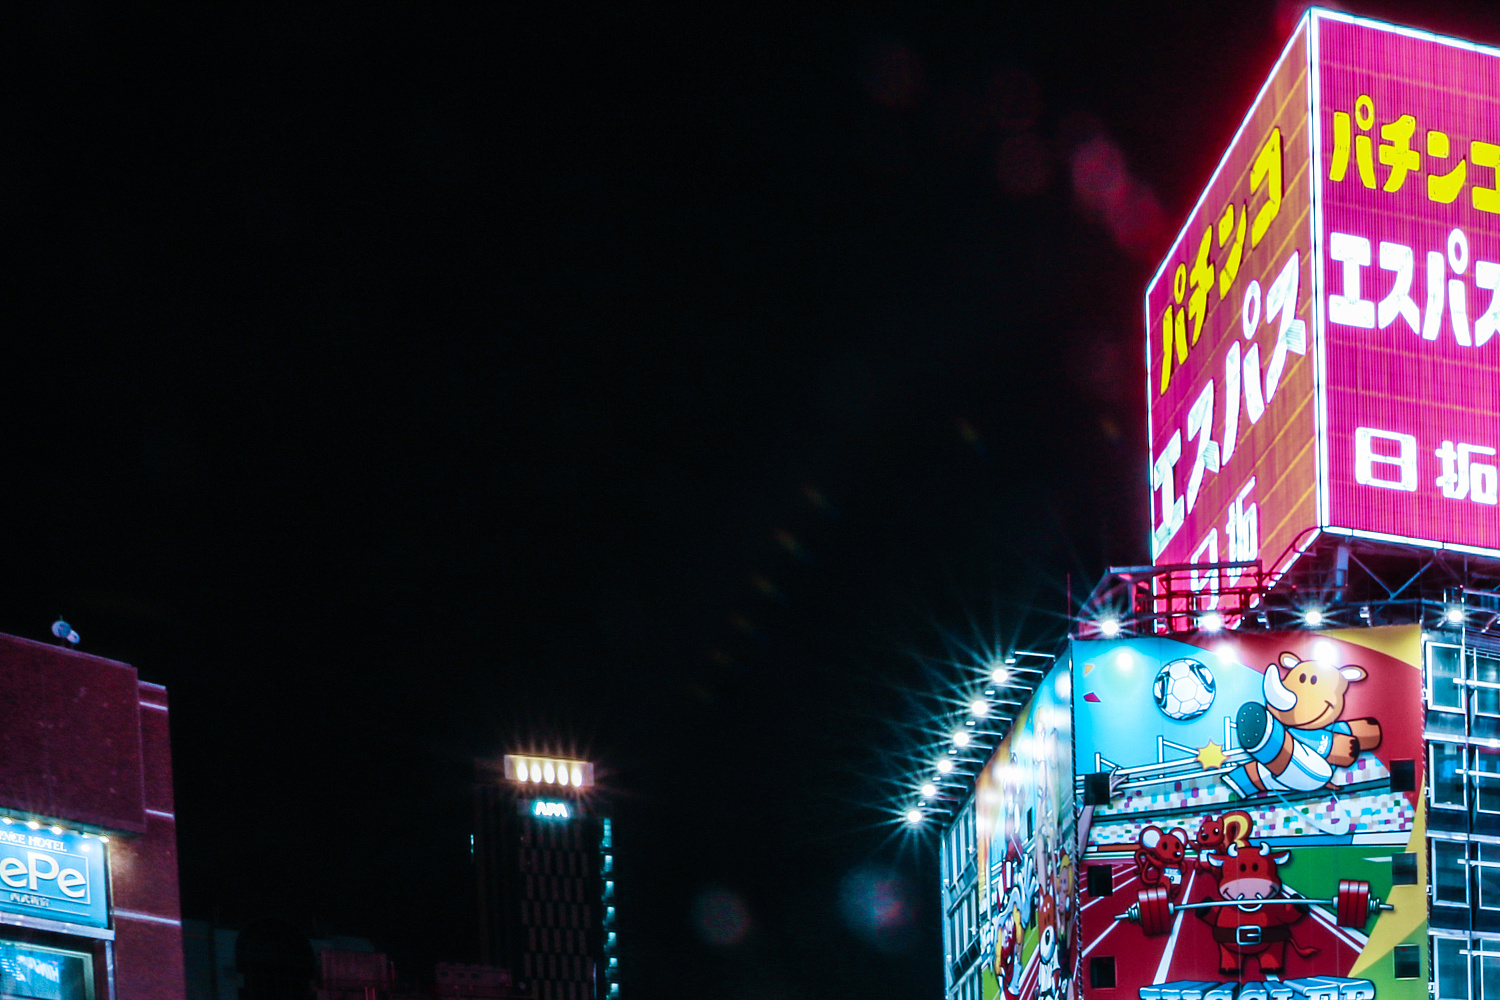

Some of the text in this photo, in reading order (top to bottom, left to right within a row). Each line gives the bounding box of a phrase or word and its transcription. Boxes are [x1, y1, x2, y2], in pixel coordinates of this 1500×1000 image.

[1158, 127, 1282, 394] パチンコ
[1153, 250, 1307, 539] エスパス
[1355, 426, 1498, 505] 日拓
[28, 836, 67, 852] HOTEL
[534, 801, 569, 818] APA
